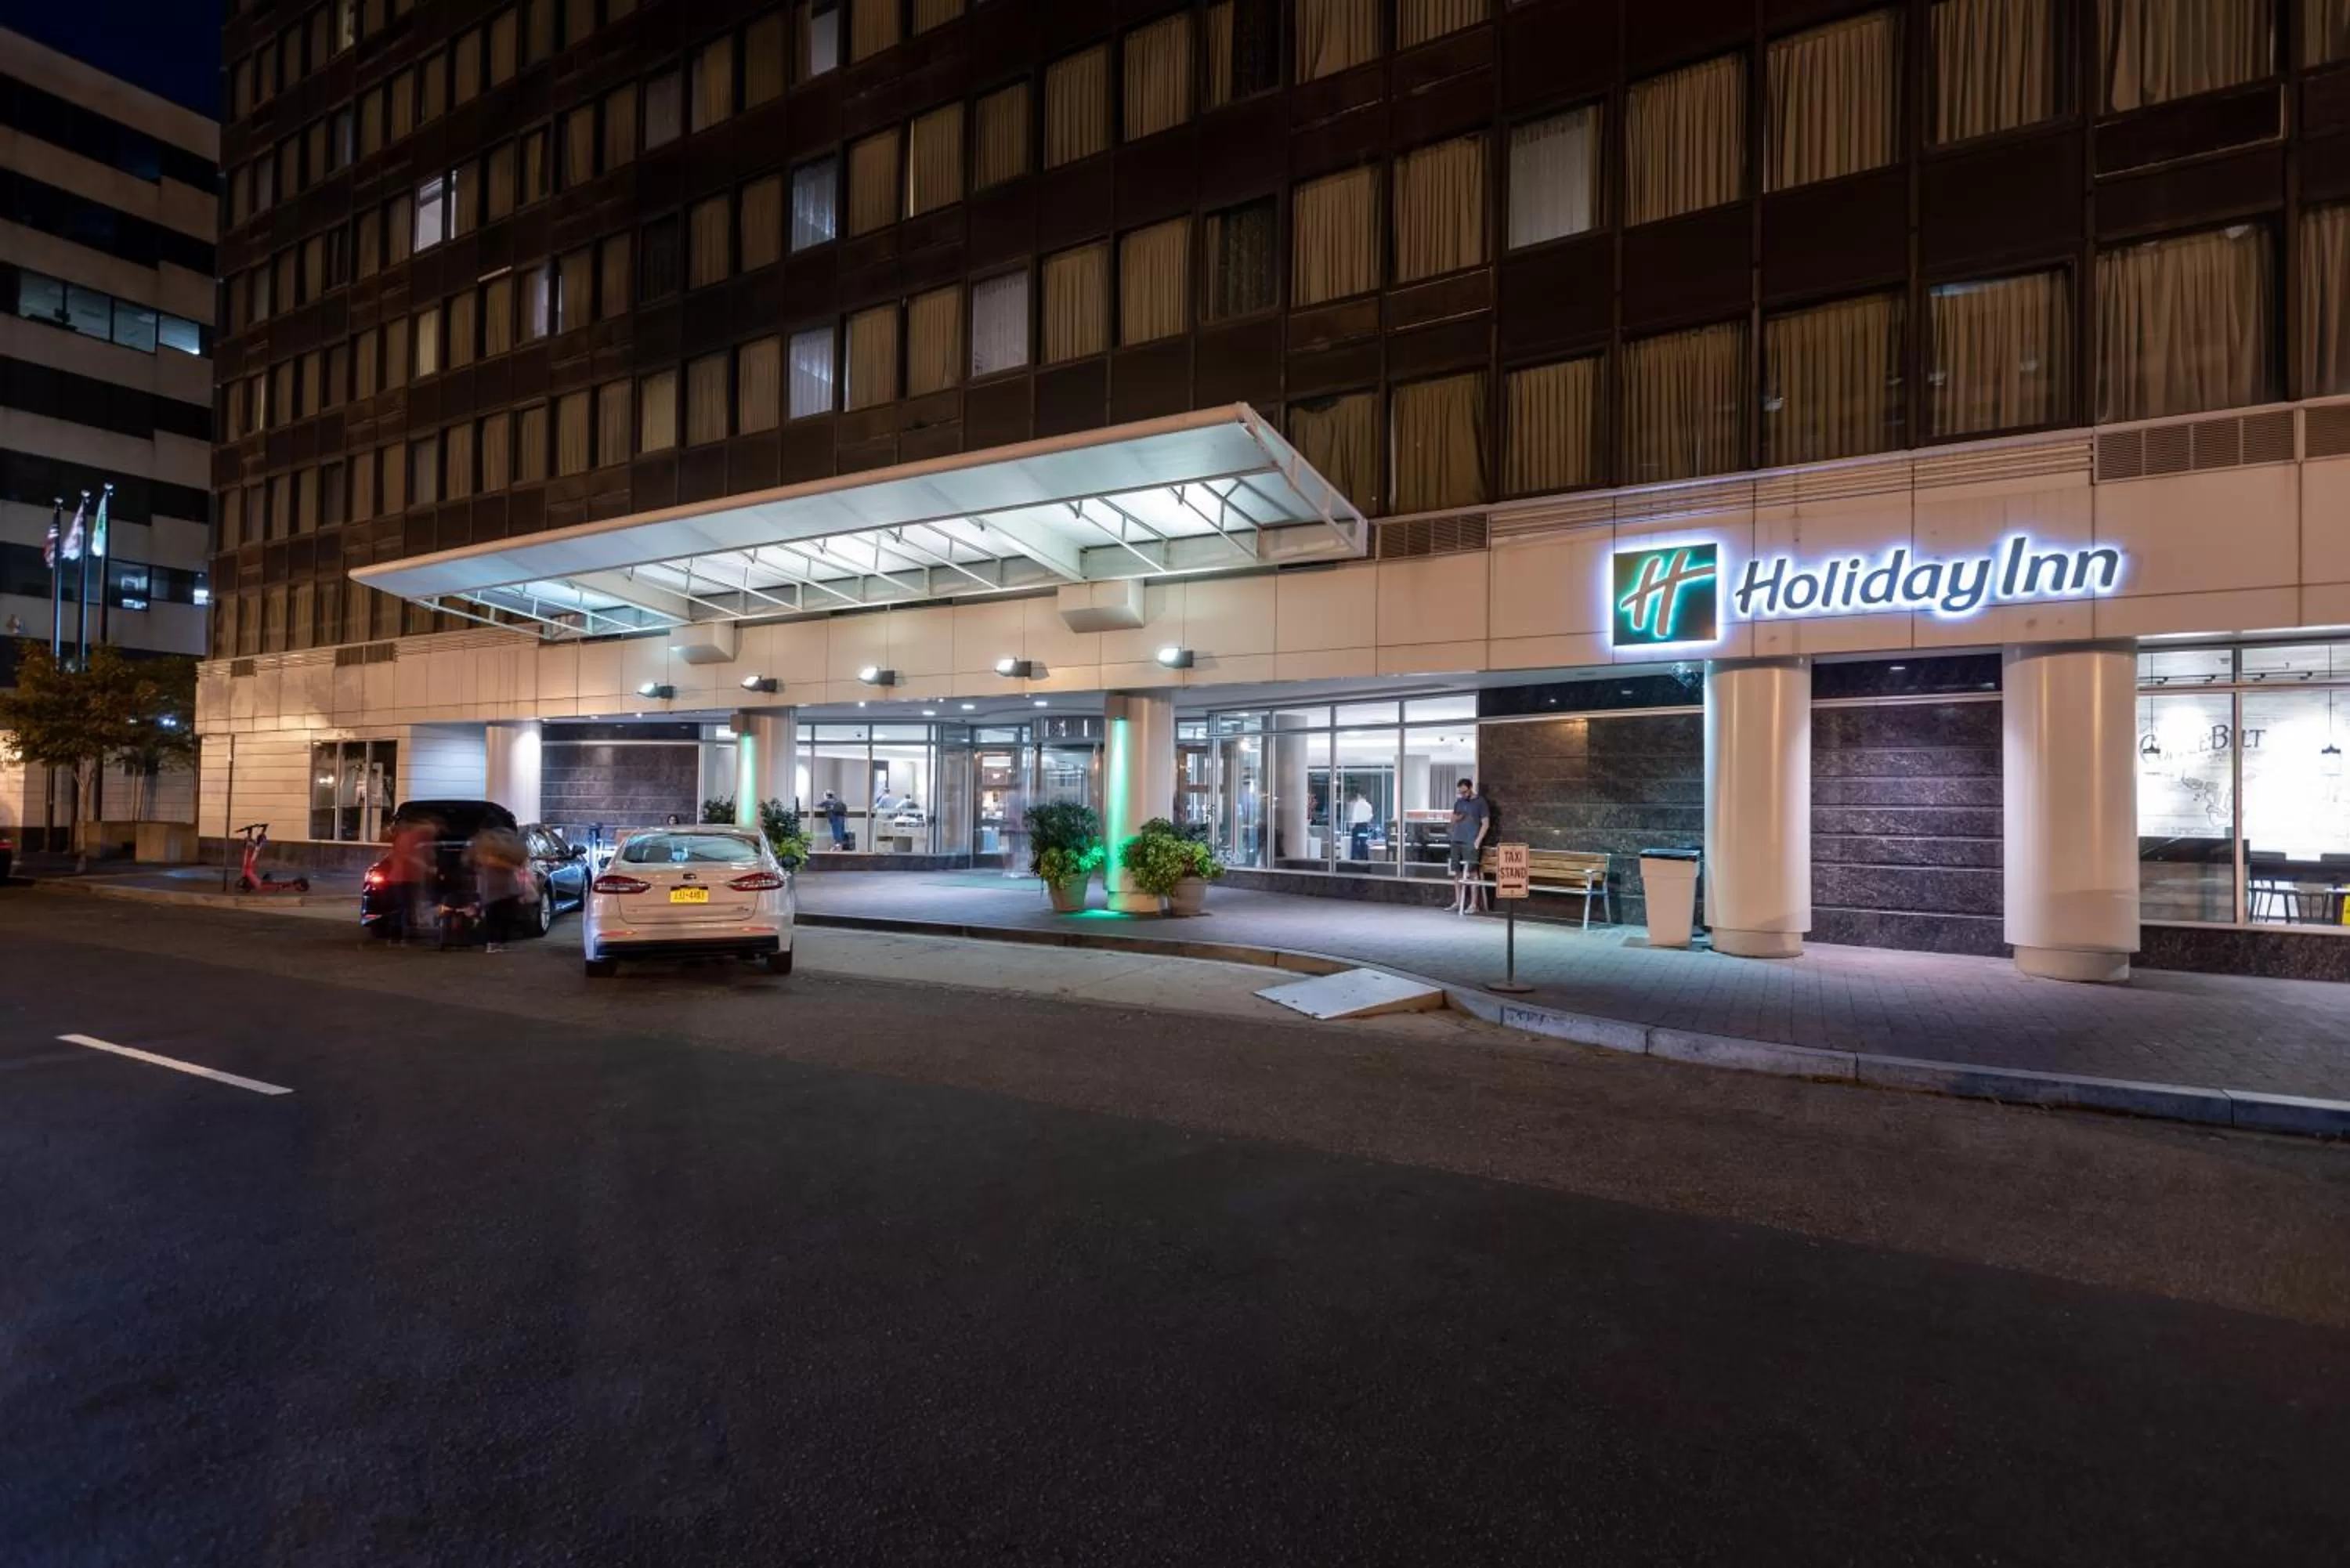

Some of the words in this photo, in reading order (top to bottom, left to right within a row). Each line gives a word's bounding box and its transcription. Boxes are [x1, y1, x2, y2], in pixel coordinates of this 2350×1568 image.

[1735, 548, 1991, 612] Holiday
[2001, 537, 2120, 595] Inn
[1504, 851, 1523, 863] TAXI
[1500, 866, 1528, 879] STAND
